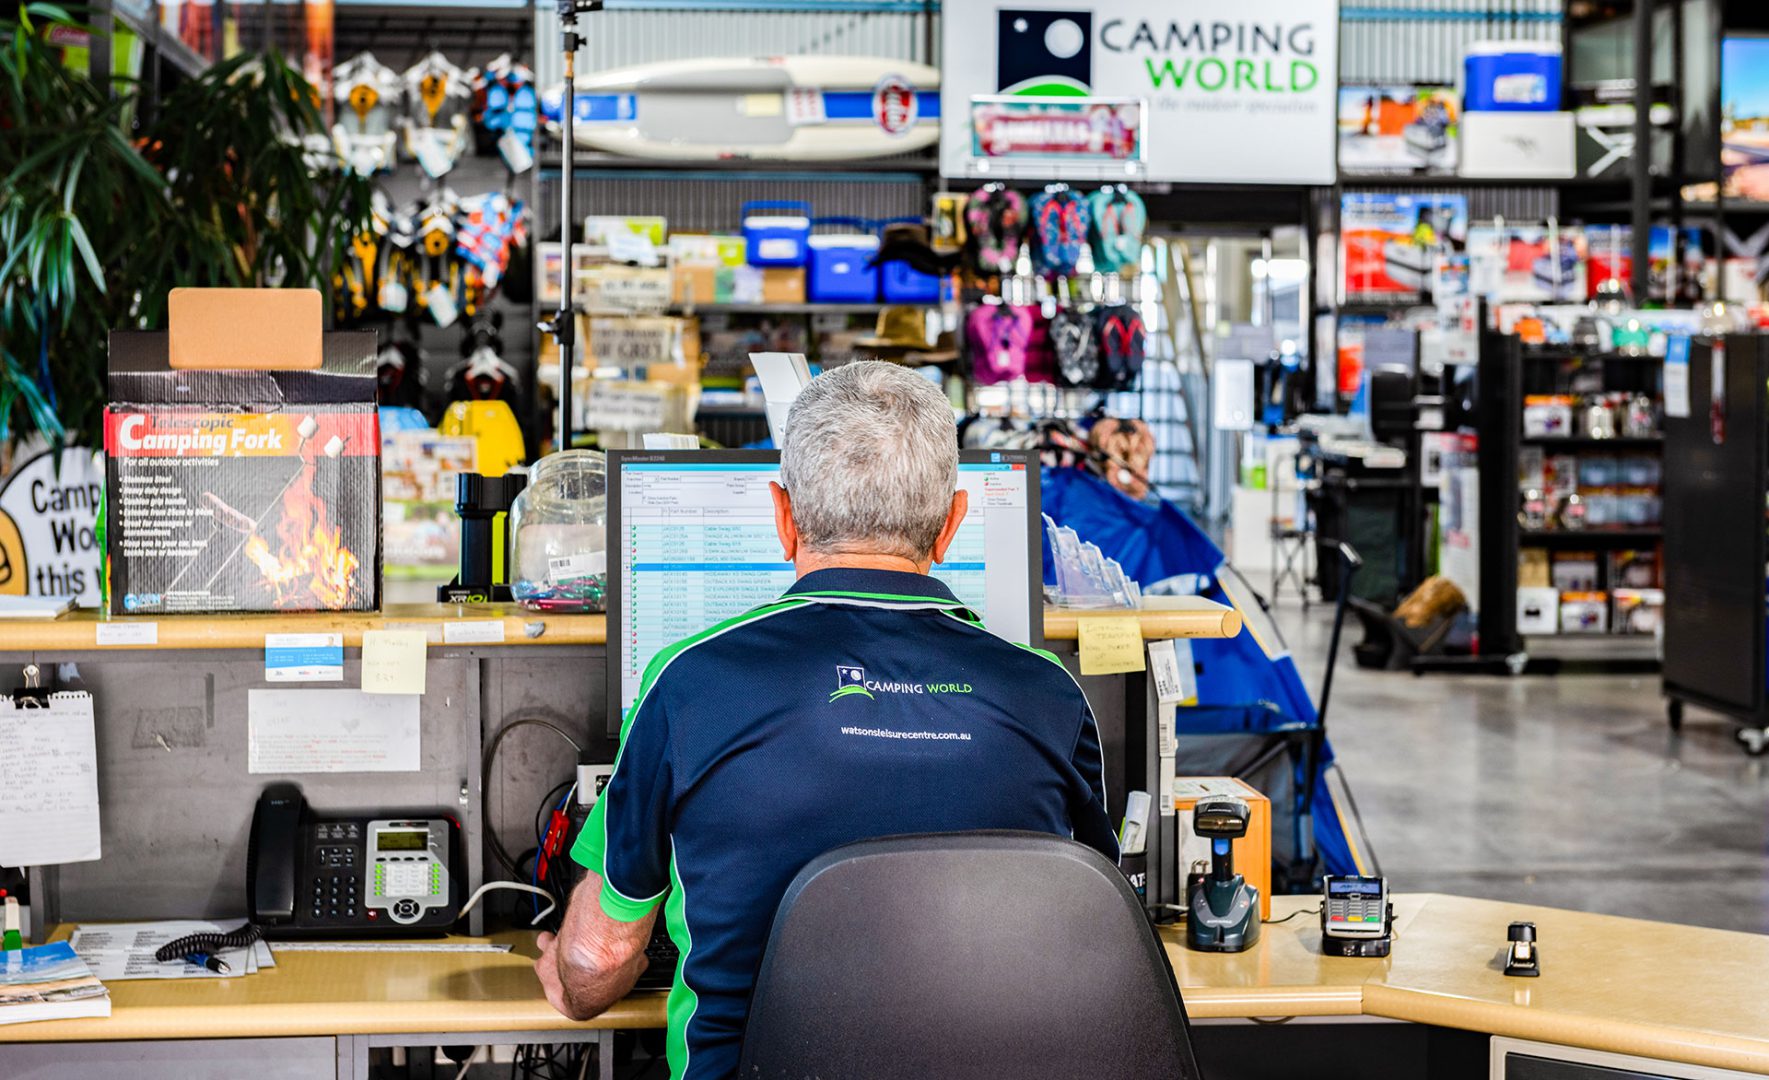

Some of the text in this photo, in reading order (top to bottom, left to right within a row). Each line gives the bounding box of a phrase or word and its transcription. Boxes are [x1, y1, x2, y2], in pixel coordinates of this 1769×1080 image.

[1100, 20, 1315, 56] CAMPING
[1144, 58, 1319, 92] WORLD
[120, 415, 282, 456] Camping Fork
[151, 415, 234, 432] Telescopic
[123, 458, 219, 467] For all outdoor activities
[31, 480, 101, 516] Camp
[37, 563, 86, 597] this
[866, 680, 973, 694] CAMPING WORLD
[841, 726, 972, 741] watsonsleisurecentre.com.au
